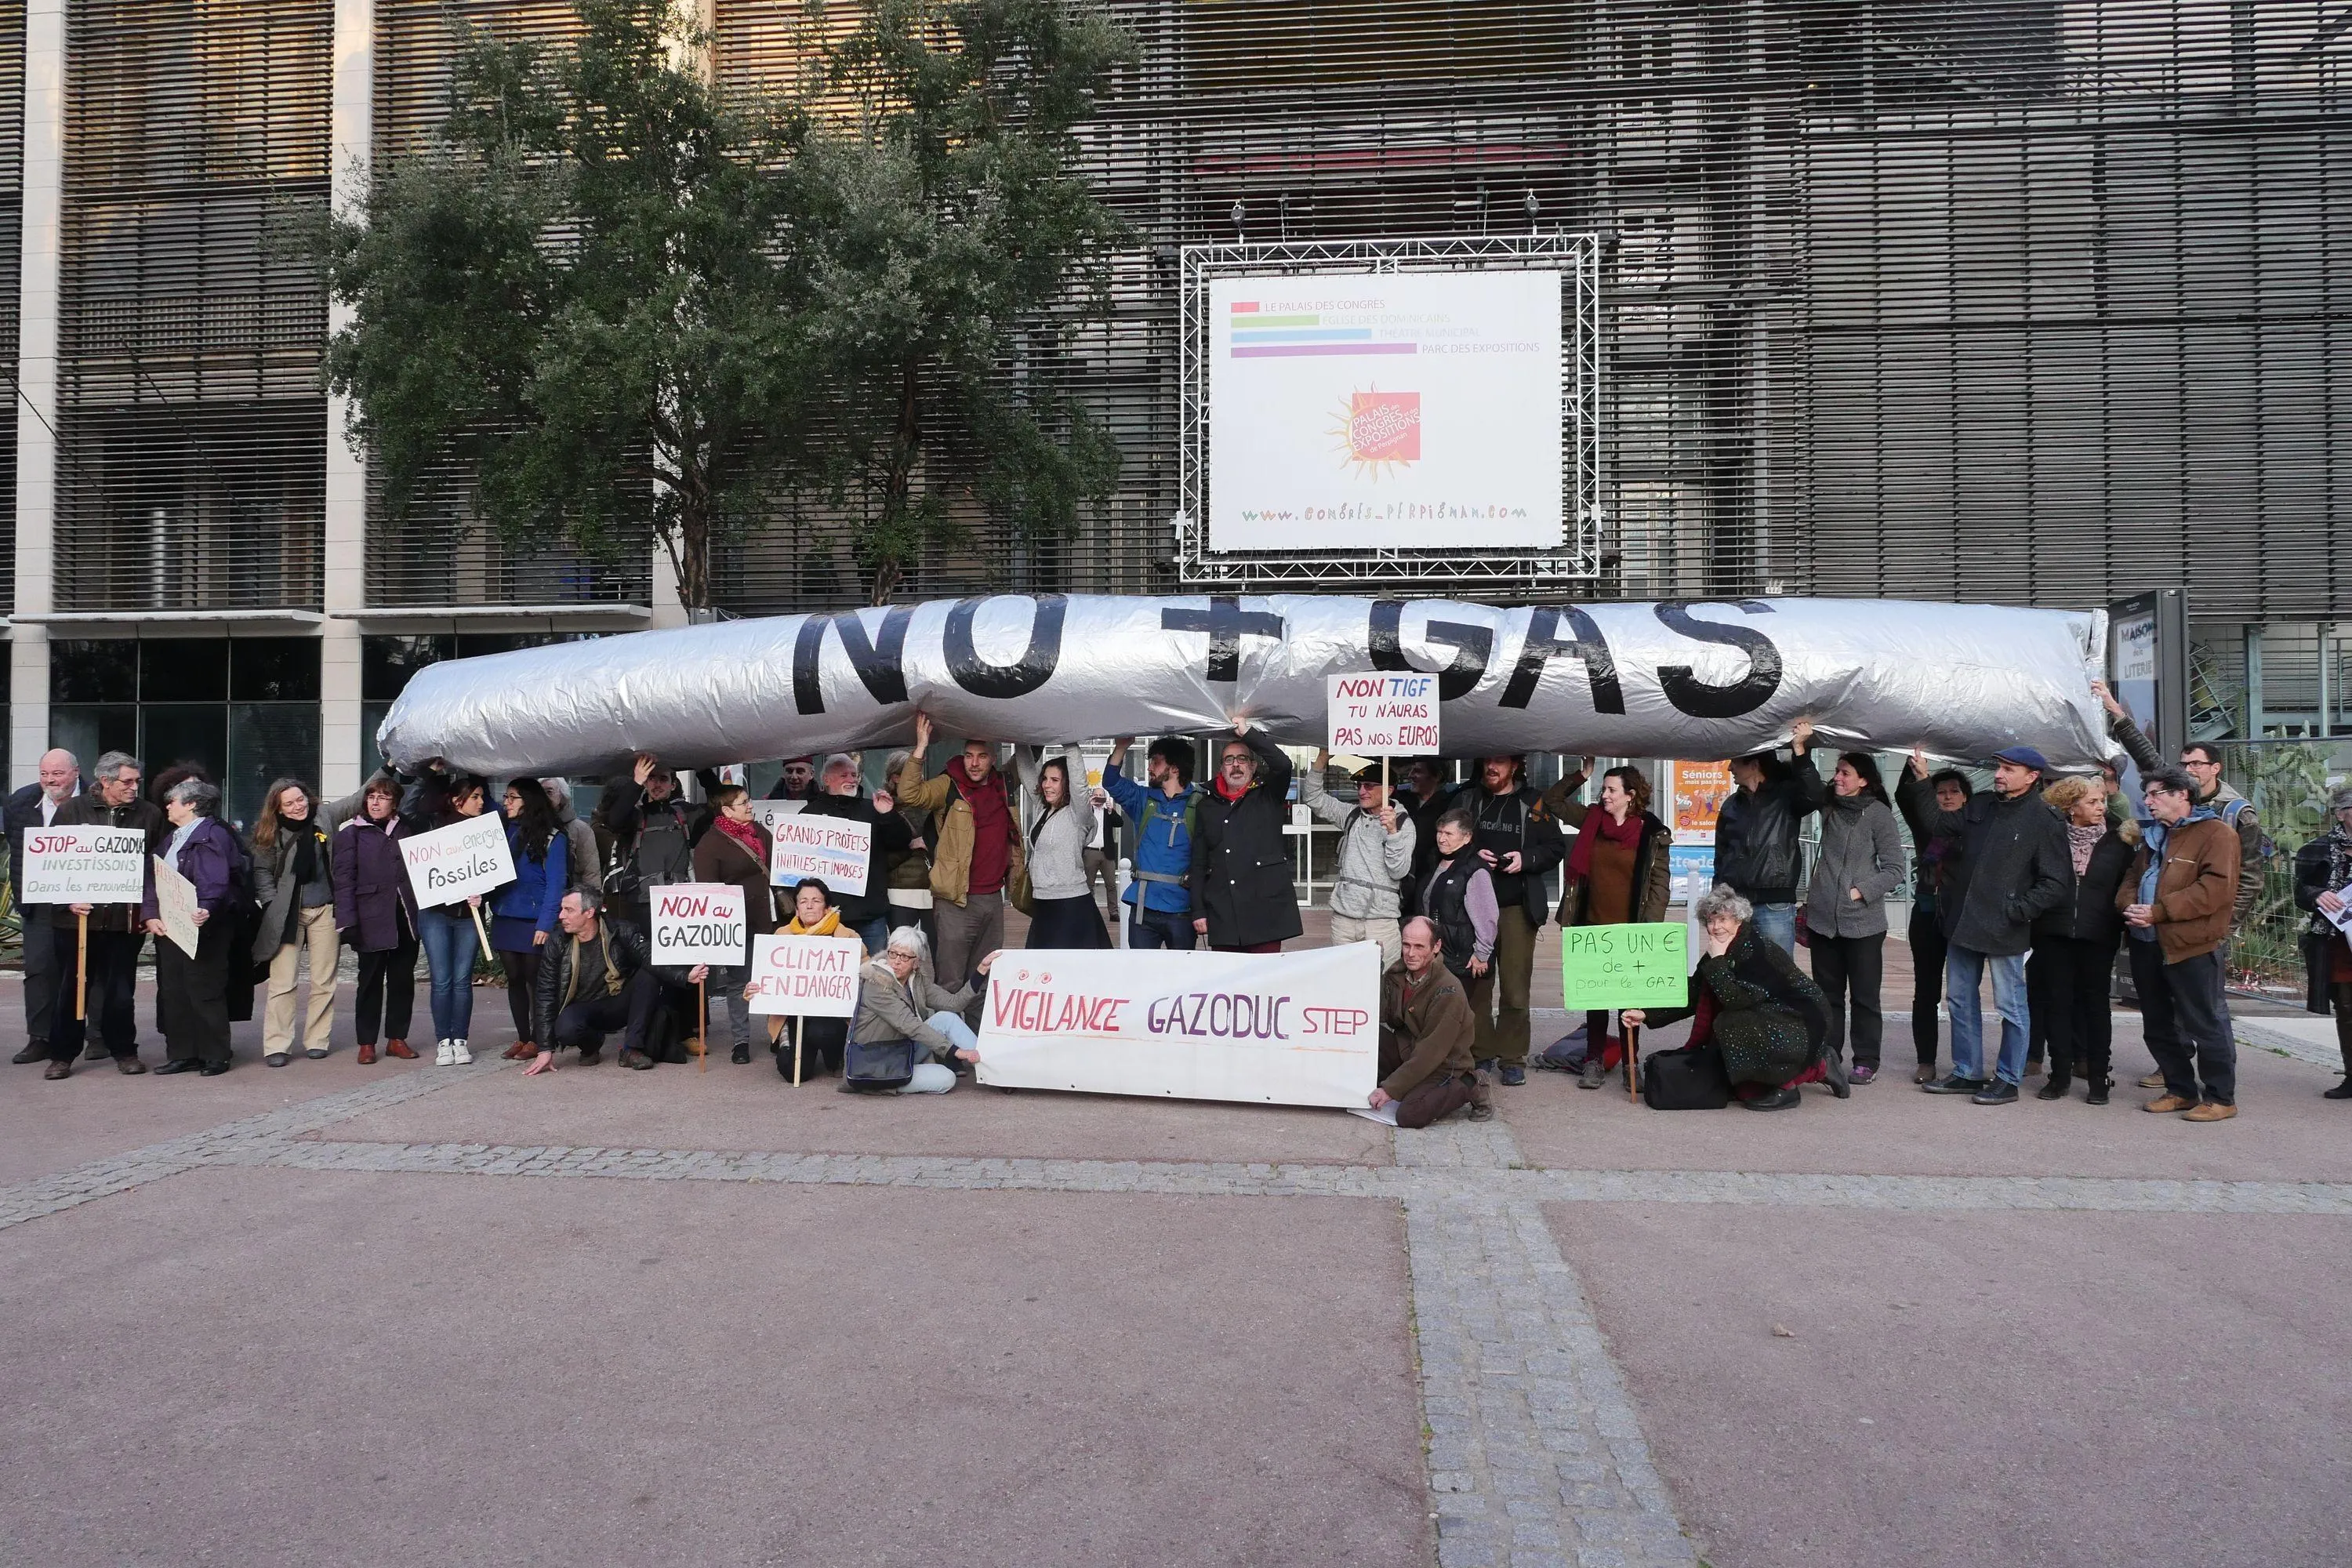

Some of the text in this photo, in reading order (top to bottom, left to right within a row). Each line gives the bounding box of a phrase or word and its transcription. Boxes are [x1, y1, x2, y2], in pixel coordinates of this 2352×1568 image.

[1265, 303, 1276, 312] LE
[1279, 301, 1312, 311] PALAIS
[1316, 300, 1334, 310] DES
[1359, 314, 1378, 325] DES
[1381, 313, 1450, 324] DOMINICAINS
[1425, 327, 1481, 338] MUNICIPAL
[1422, 342, 1541, 354] PARC DES EXPOSITIONS
[1353, 404, 1389, 427] PALAIS
[1352, 412, 1421, 452] EXPOSITIONS
[793, 592, 1784, 718] NO + GAS
[1336, 678, 1432, 698] NON TIGF
[1348, 706, 1367, 717] TU
[1334, 725, 1438, 746] PAS NOS EUROS
[1682, 770, 1723, 779] Séniors
[28, 835, 77, 853] STOP
[95, 837, 145, 853] GAZODUC
[776, 823, 869, 852] GRANDS PROJETS
[409, 842, 441, 866] NON
[446, 844, 464, 856] aux
[818, 861, 829, 874] ET
[27, 880, 60, 893] Dans
[66, 877, 82, 892] les
[659, 896, 733, 918] NON au
[658, 923, 743, 947] GAZODUC
[1572, 931, 1613, 954] PAS
[1628, 932, 1653, 953] UN
[770, 946, 850, 971] CLIMAT
[1602, 956, 1646, 974] de +
[760, 975, 851, 1000] EN DANGER
[1576, 976, 1676, 996] pour le GAZ
[1147, 993, 1290, 1040] GAZODUC
[1302, 1007, 1370, 1036] STEP
